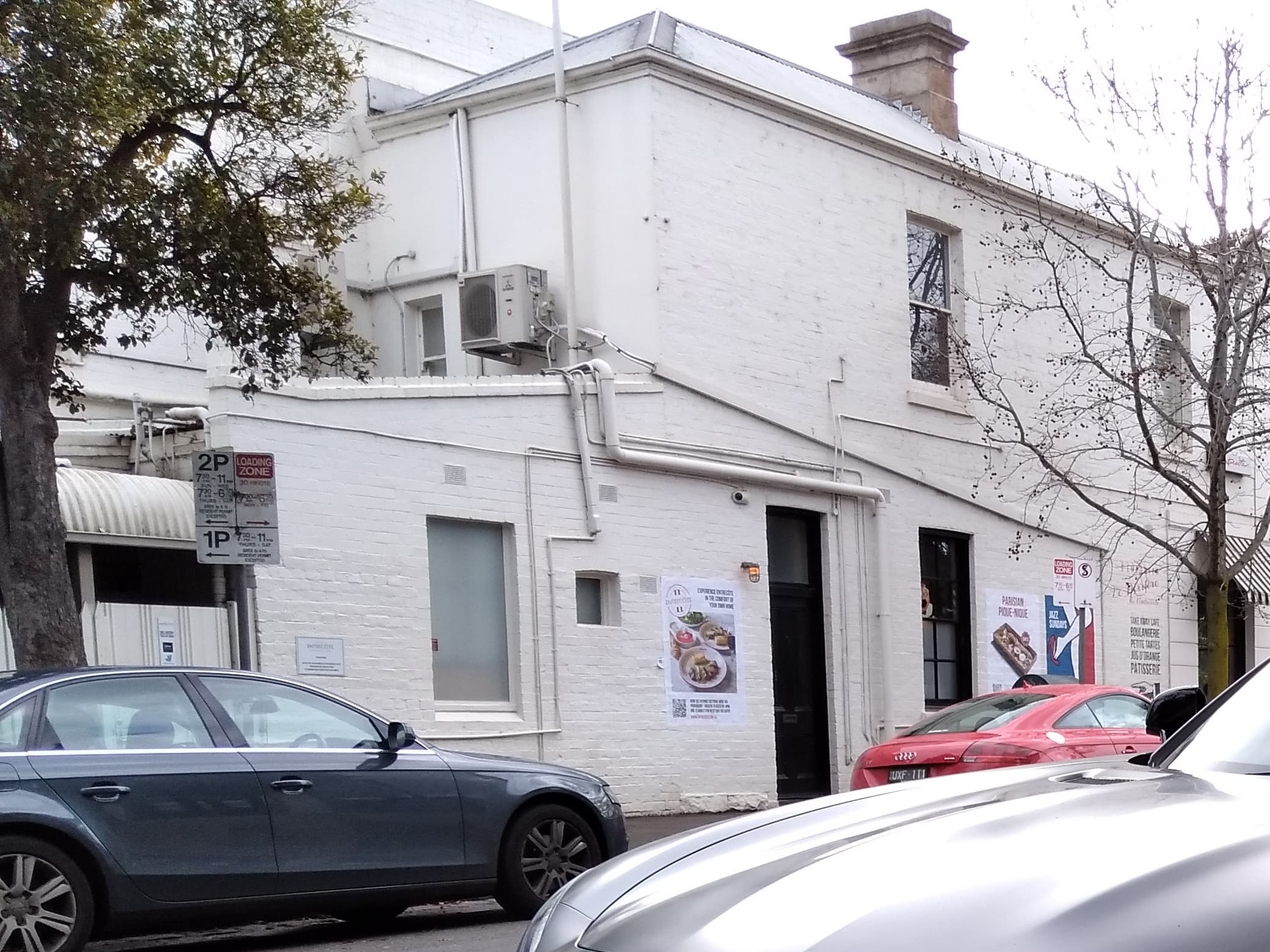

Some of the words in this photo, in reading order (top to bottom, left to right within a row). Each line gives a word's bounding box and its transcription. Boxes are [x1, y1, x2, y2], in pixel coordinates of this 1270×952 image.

[198, 454, 229, 471] 2P
[236, 457, 272, 467] LOADING
[239, 467, 270, 476] ZONE
[203, 531, 230, 548] 1P
[1001, 595, 1024, 607] PARISIAN
[998, 606, 1028, 619] PIQUE-NIQUE
[1048, 610, 1059, 620] JAZZ
[1048, 620, 1067, 629] SUNDAYS
[1130, 627, 1160, 638] BOULANGERIE
[1130, 639, 1145, 649] PETITE
[1130, 650, 1139, 661] JUS
[1130, 662, 1160, 675] PATISSERIE
